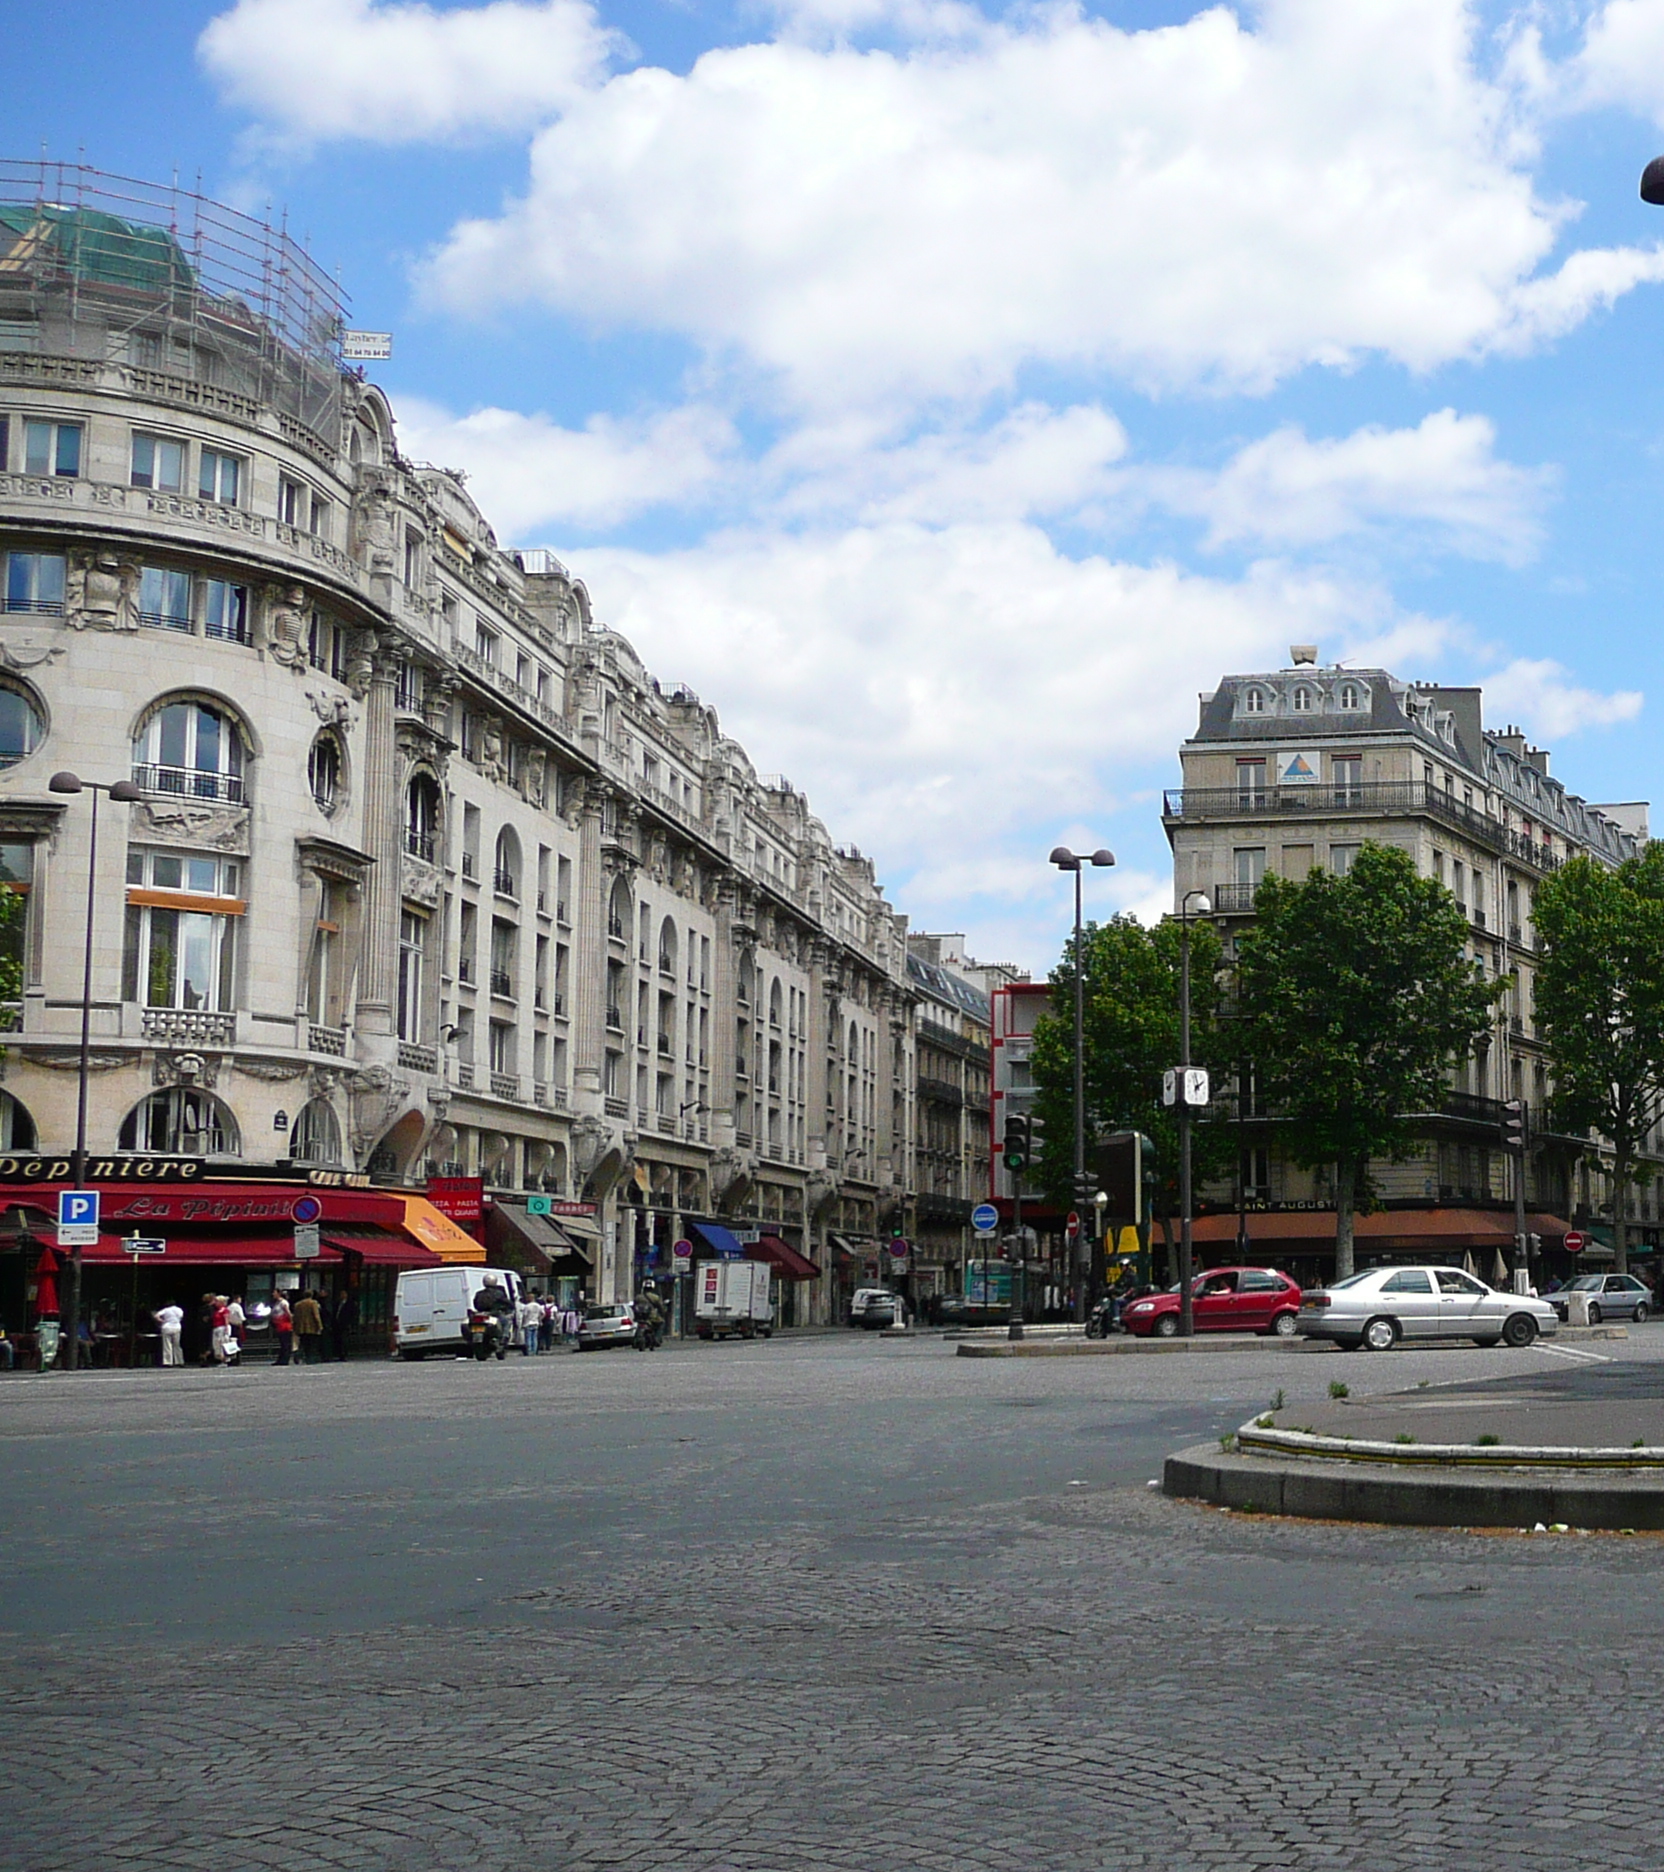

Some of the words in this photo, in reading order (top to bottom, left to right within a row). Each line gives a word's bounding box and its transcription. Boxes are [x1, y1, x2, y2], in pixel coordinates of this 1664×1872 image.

[114, 1196, 169, 1219] La
[181, 1198, 291, 1221] Pépiniè
[1279, 1200, 1338, 1209] AUGUSTI
